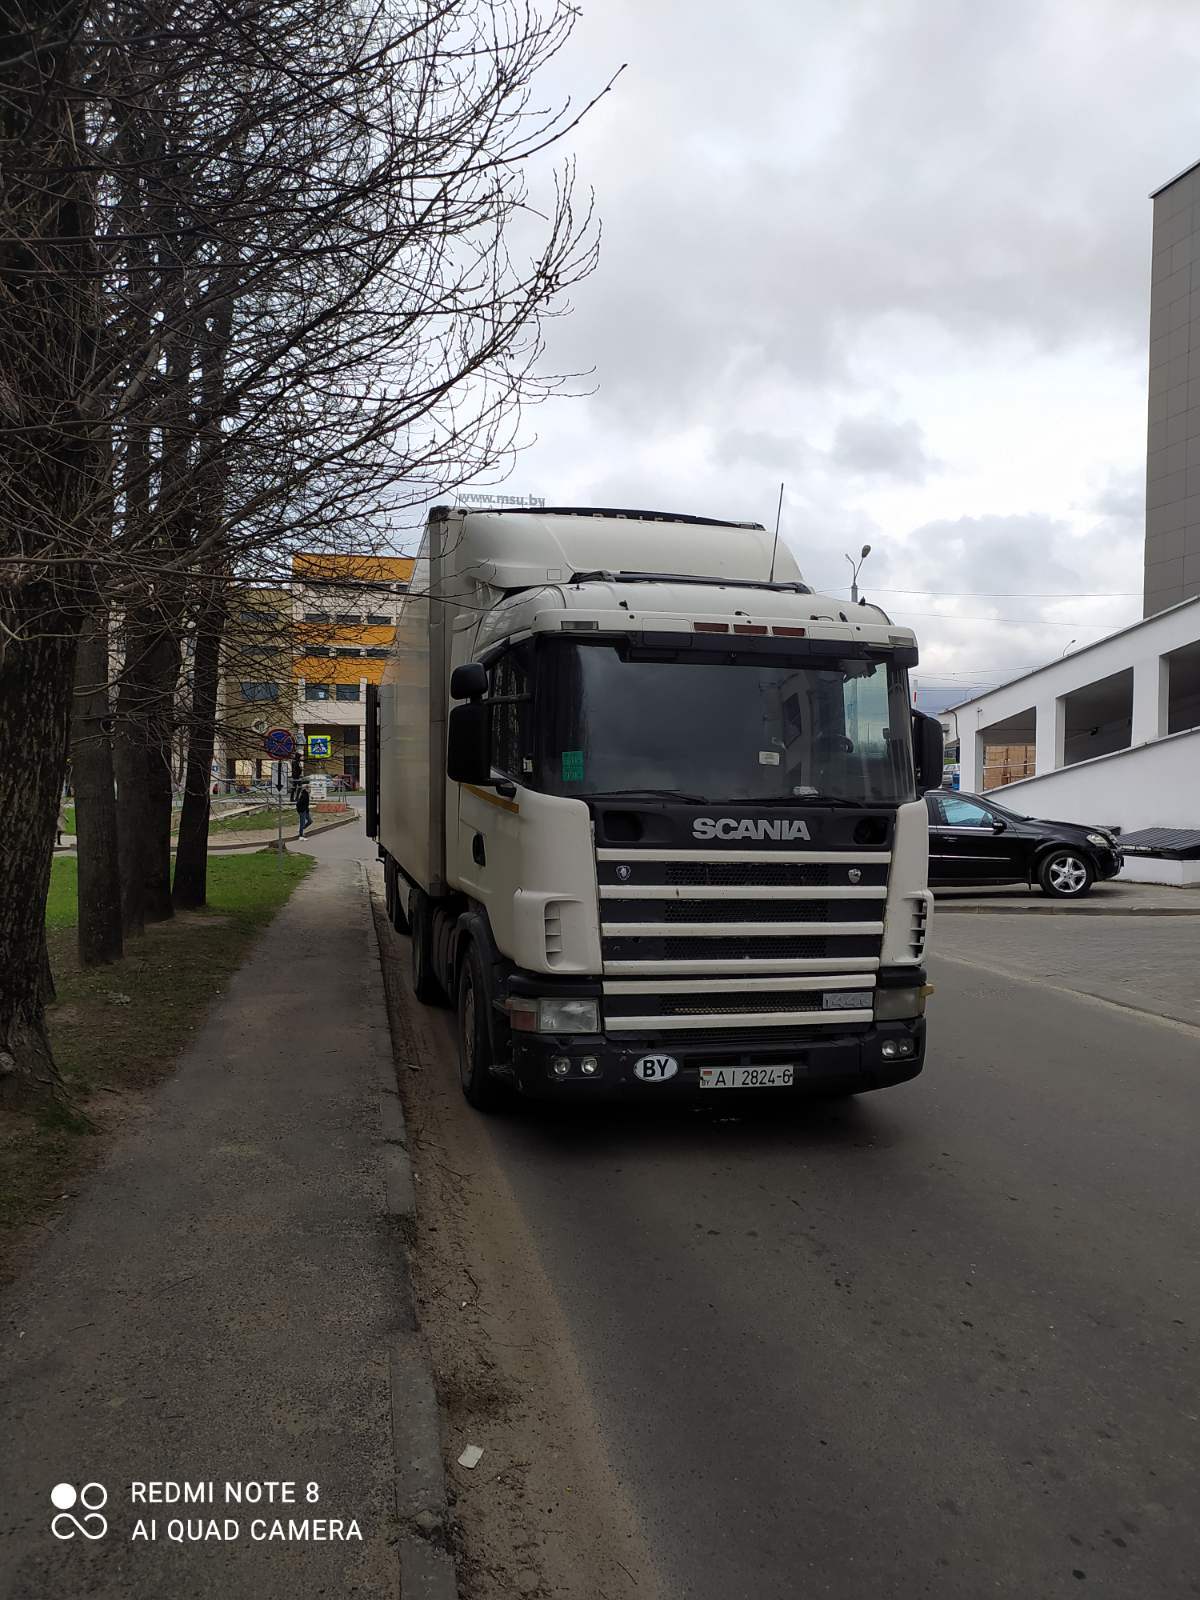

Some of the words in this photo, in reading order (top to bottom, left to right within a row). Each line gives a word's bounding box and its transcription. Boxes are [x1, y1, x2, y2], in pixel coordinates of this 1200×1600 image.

[459, 493, 546, 506] www.msu.by
[692, 817, 811, 841] SCANIA
[642, 1058, 670, 1078] BY
